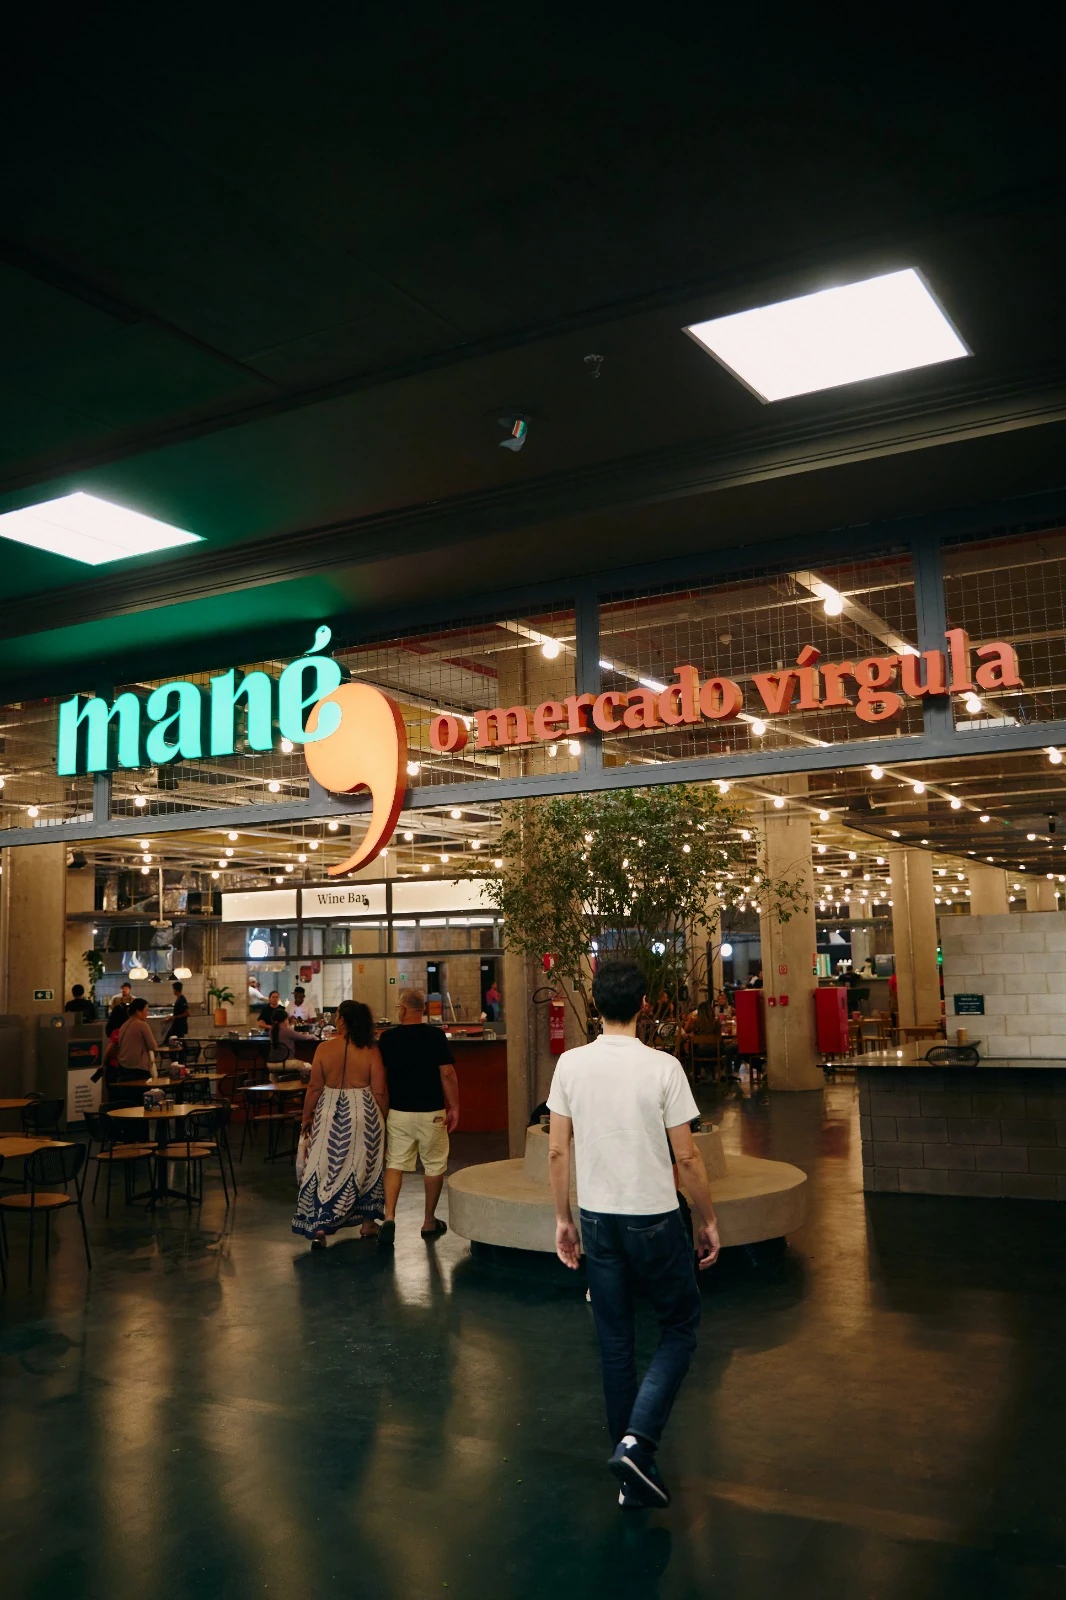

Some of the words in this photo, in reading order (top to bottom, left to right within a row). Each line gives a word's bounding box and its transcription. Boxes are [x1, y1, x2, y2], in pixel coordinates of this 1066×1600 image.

[429, 715, 466, 751] o
[474, 665, 742, 747] mercado
[752, 628, 1023, 722] vírgula
[317, 893, 345, 904] Wine
